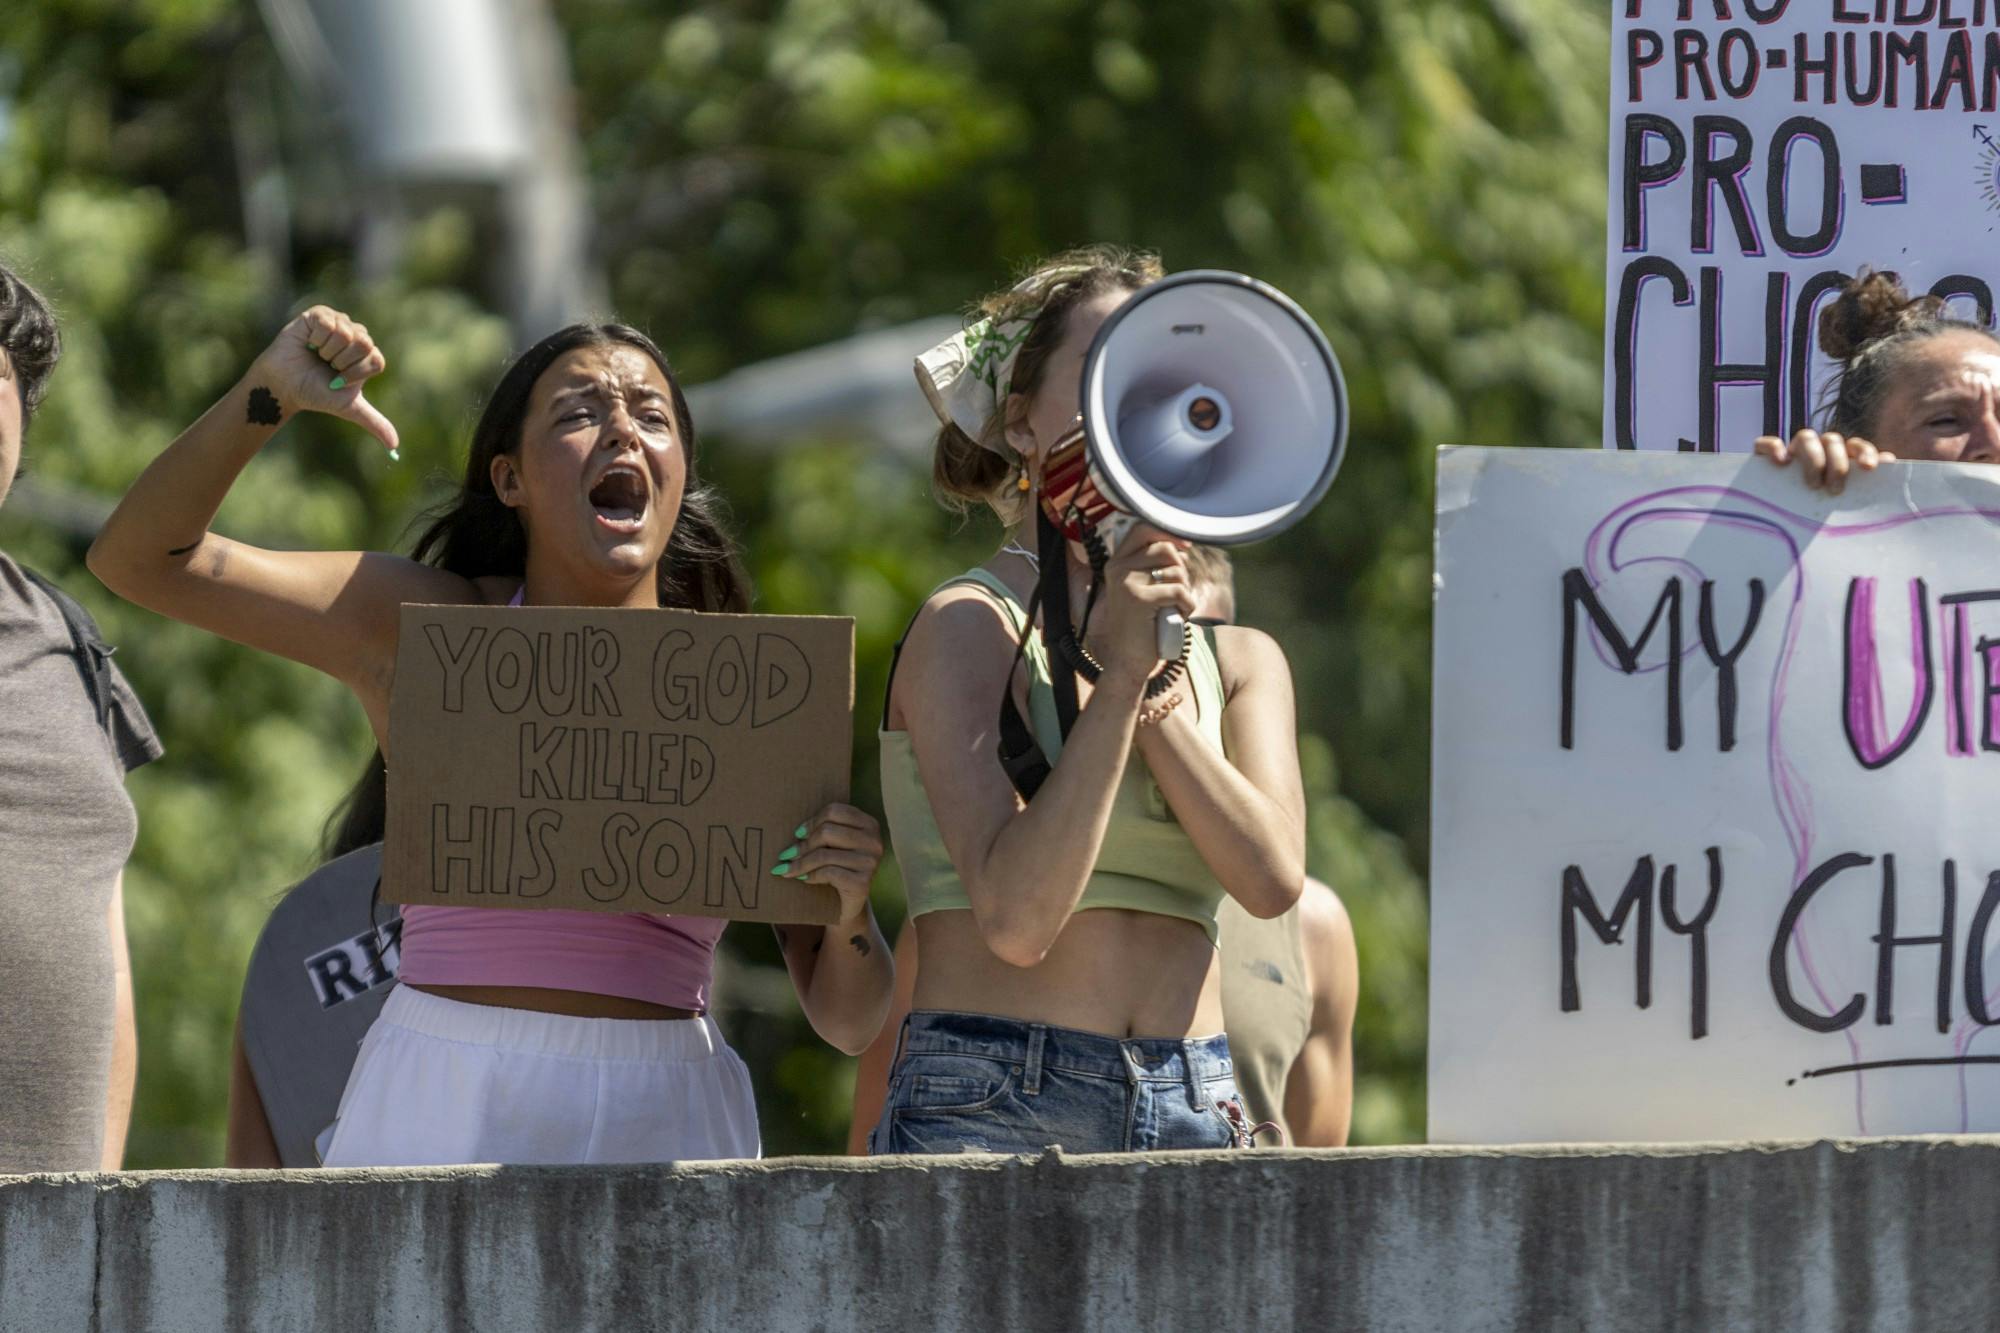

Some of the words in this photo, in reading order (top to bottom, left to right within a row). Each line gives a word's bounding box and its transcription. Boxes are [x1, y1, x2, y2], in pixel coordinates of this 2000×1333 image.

[1623, 113, 1907, 257] PRO-
[424, 624, 622, 717] YOUR
[652, 629, 812, 729] GOD
[1560, 566, 1765, 752] MY
[519, 722, 715, 806] KILLED
[432, 804, 563, 897] HIS
[582, 812, 764, 909] SON
[1560, 847, 1723, 1039] MY
